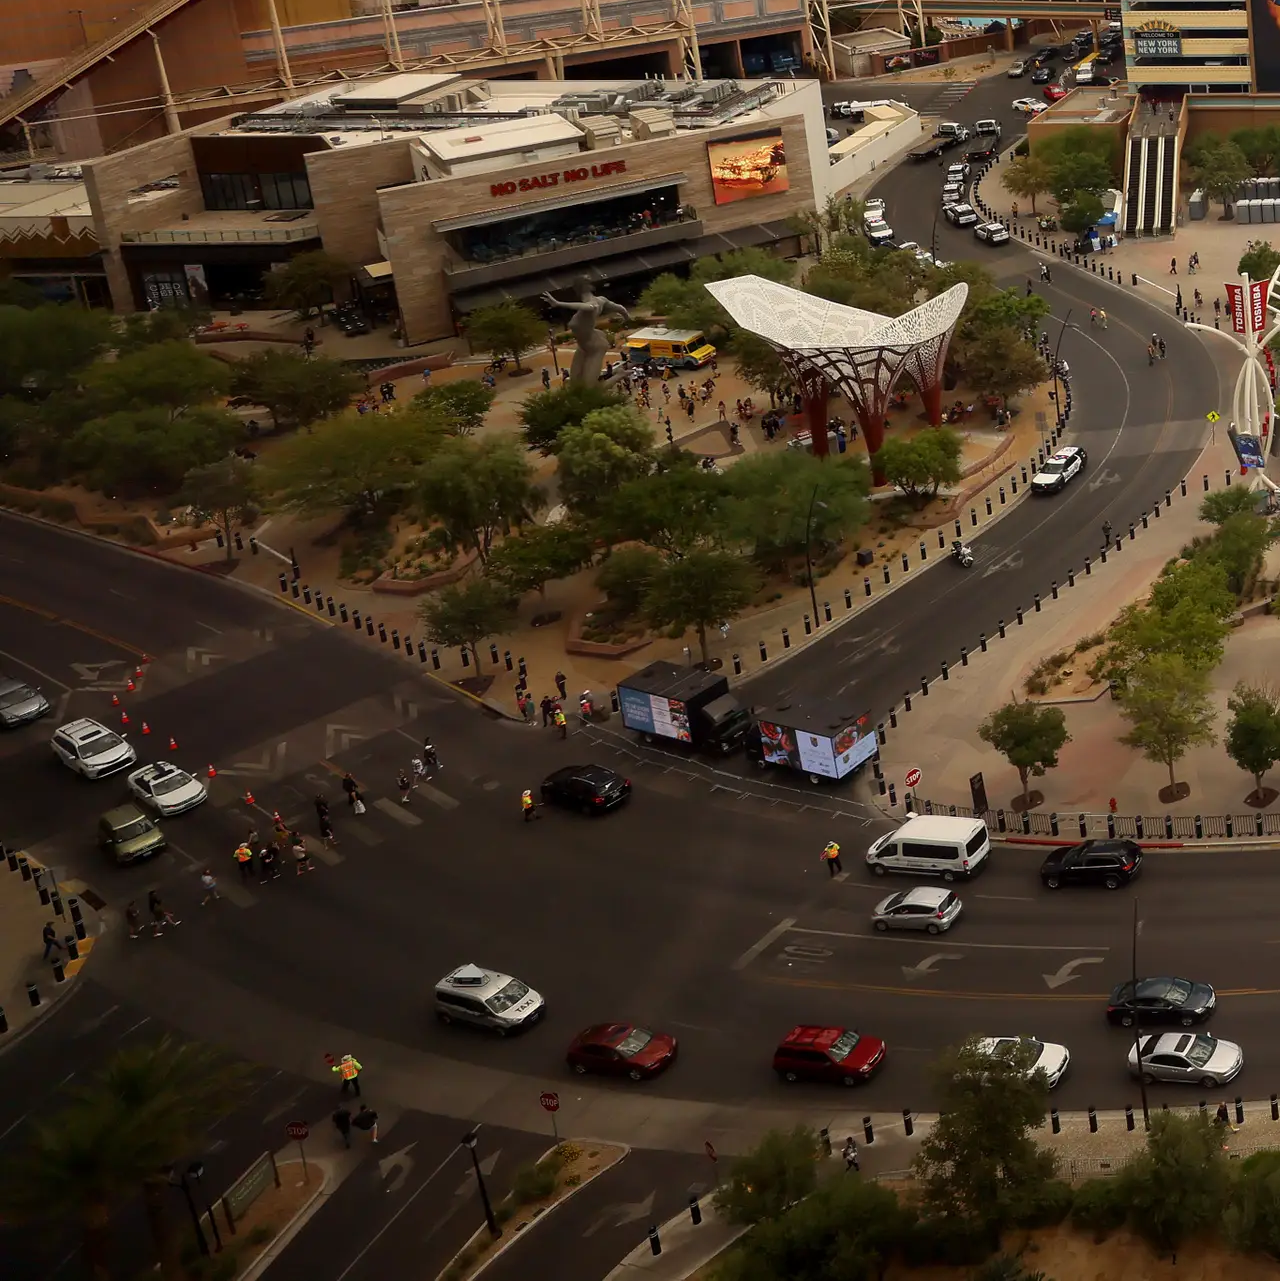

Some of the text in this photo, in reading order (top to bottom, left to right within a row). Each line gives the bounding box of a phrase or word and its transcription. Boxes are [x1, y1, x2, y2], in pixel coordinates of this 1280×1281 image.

[490, 160, 627, 197] NO SALT NO LIFE
[1234, 288, 1243, 330] TOSHIBA
[1253, 285, 1262, 329] TOSHIBA
[905, 771, 920, 785] STOP
[515, 999, 535, 1013] TAXI
[541, 1097, 558, 1107] STOP
[287, 1126, 308, 1135] STOP
